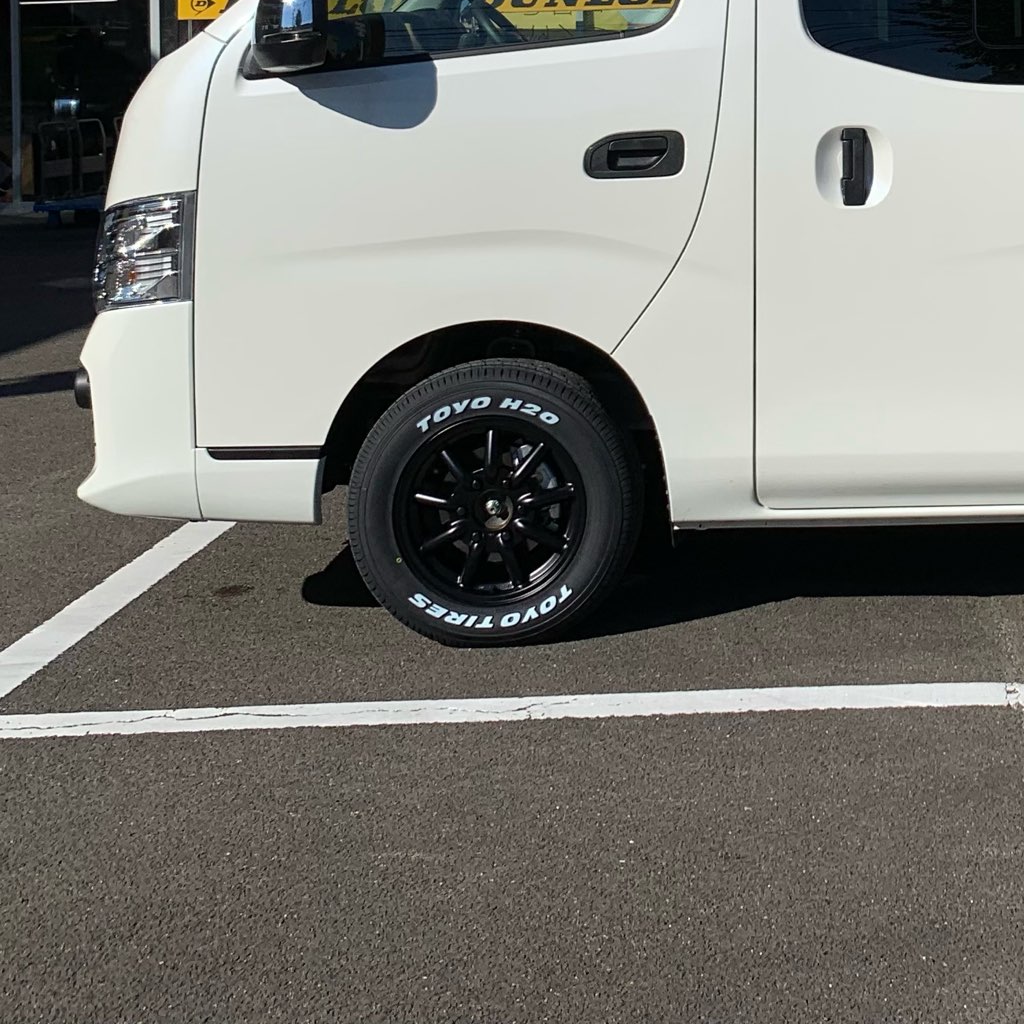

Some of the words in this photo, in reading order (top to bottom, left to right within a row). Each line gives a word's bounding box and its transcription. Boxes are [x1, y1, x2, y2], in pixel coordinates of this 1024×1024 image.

[415, 396, 492, 433] TOYO
[407, 592, 495, 629] TIRES
[499, 583, 574, 627] TOYO
